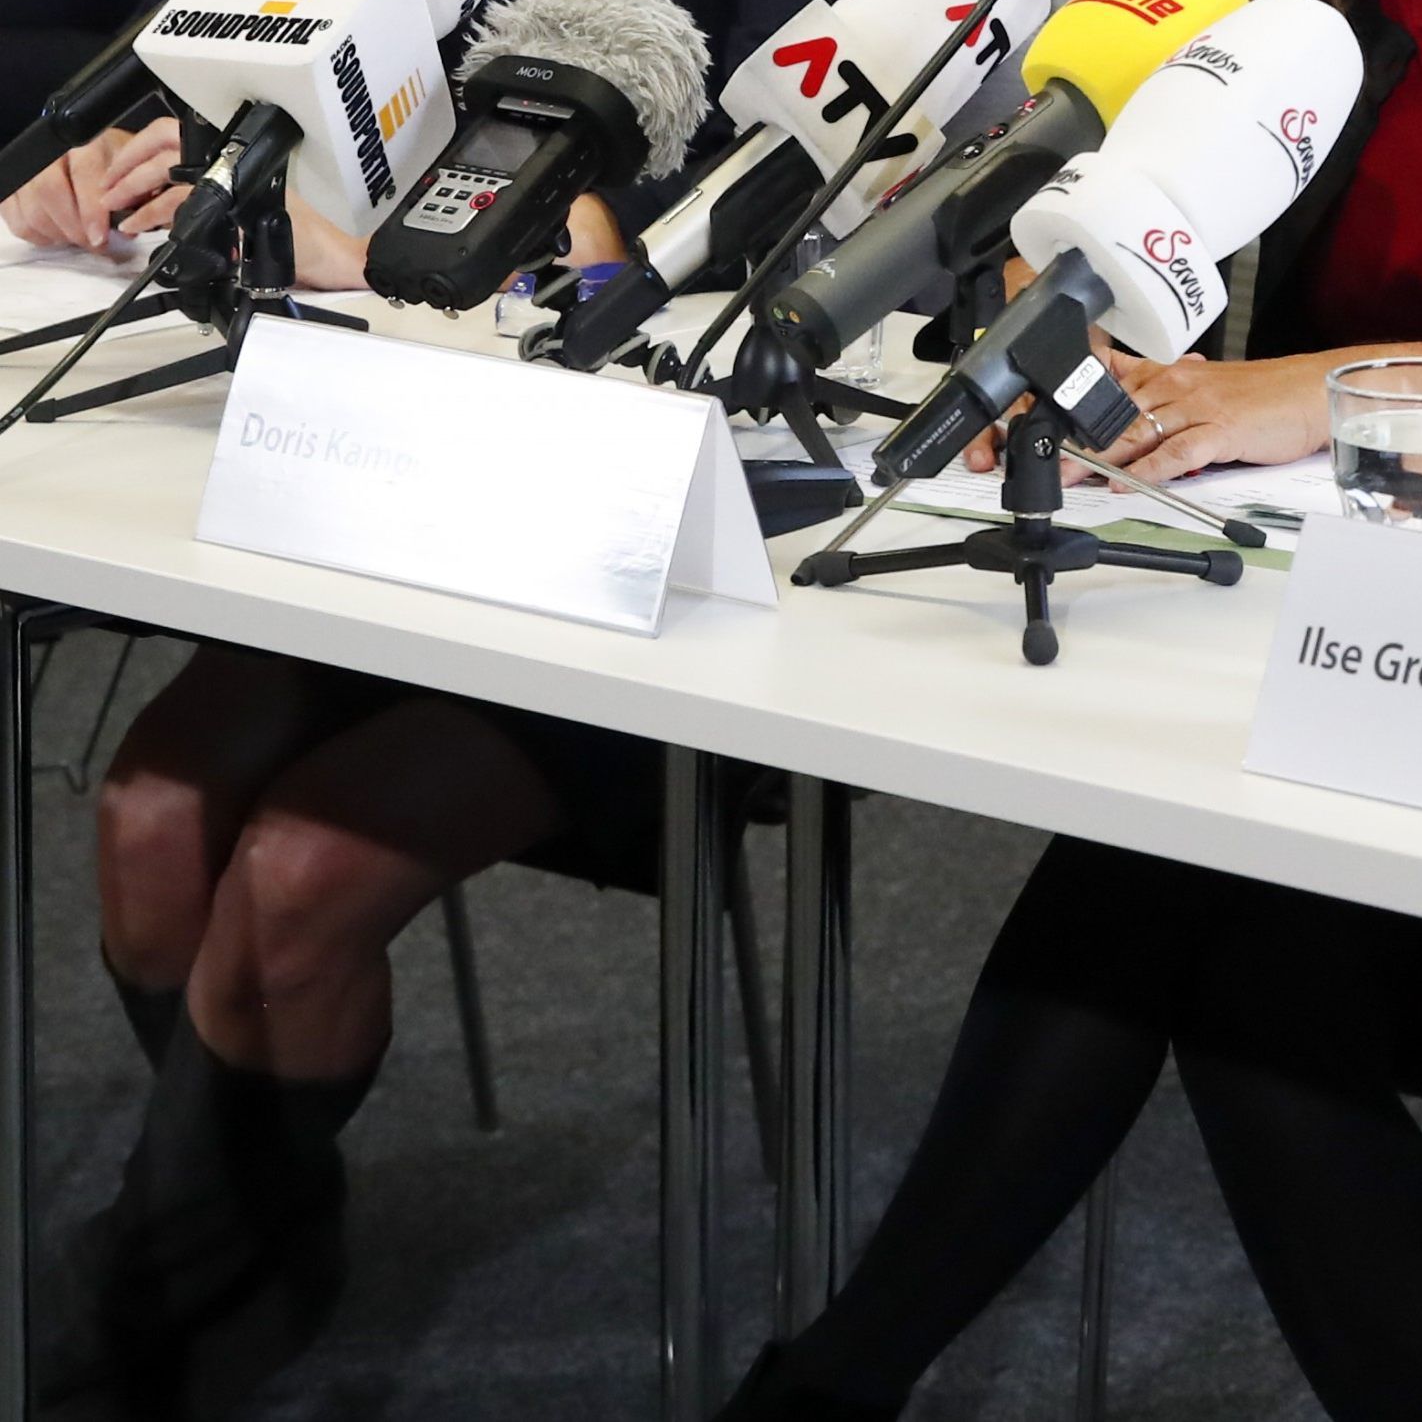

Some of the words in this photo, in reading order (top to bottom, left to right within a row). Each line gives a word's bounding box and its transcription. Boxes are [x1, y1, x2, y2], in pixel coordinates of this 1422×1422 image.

[516, 66, 553, 80] MOVO
[240, 412, 318, 458] Doris
[1300, 627, 1363, 675] Ilse
